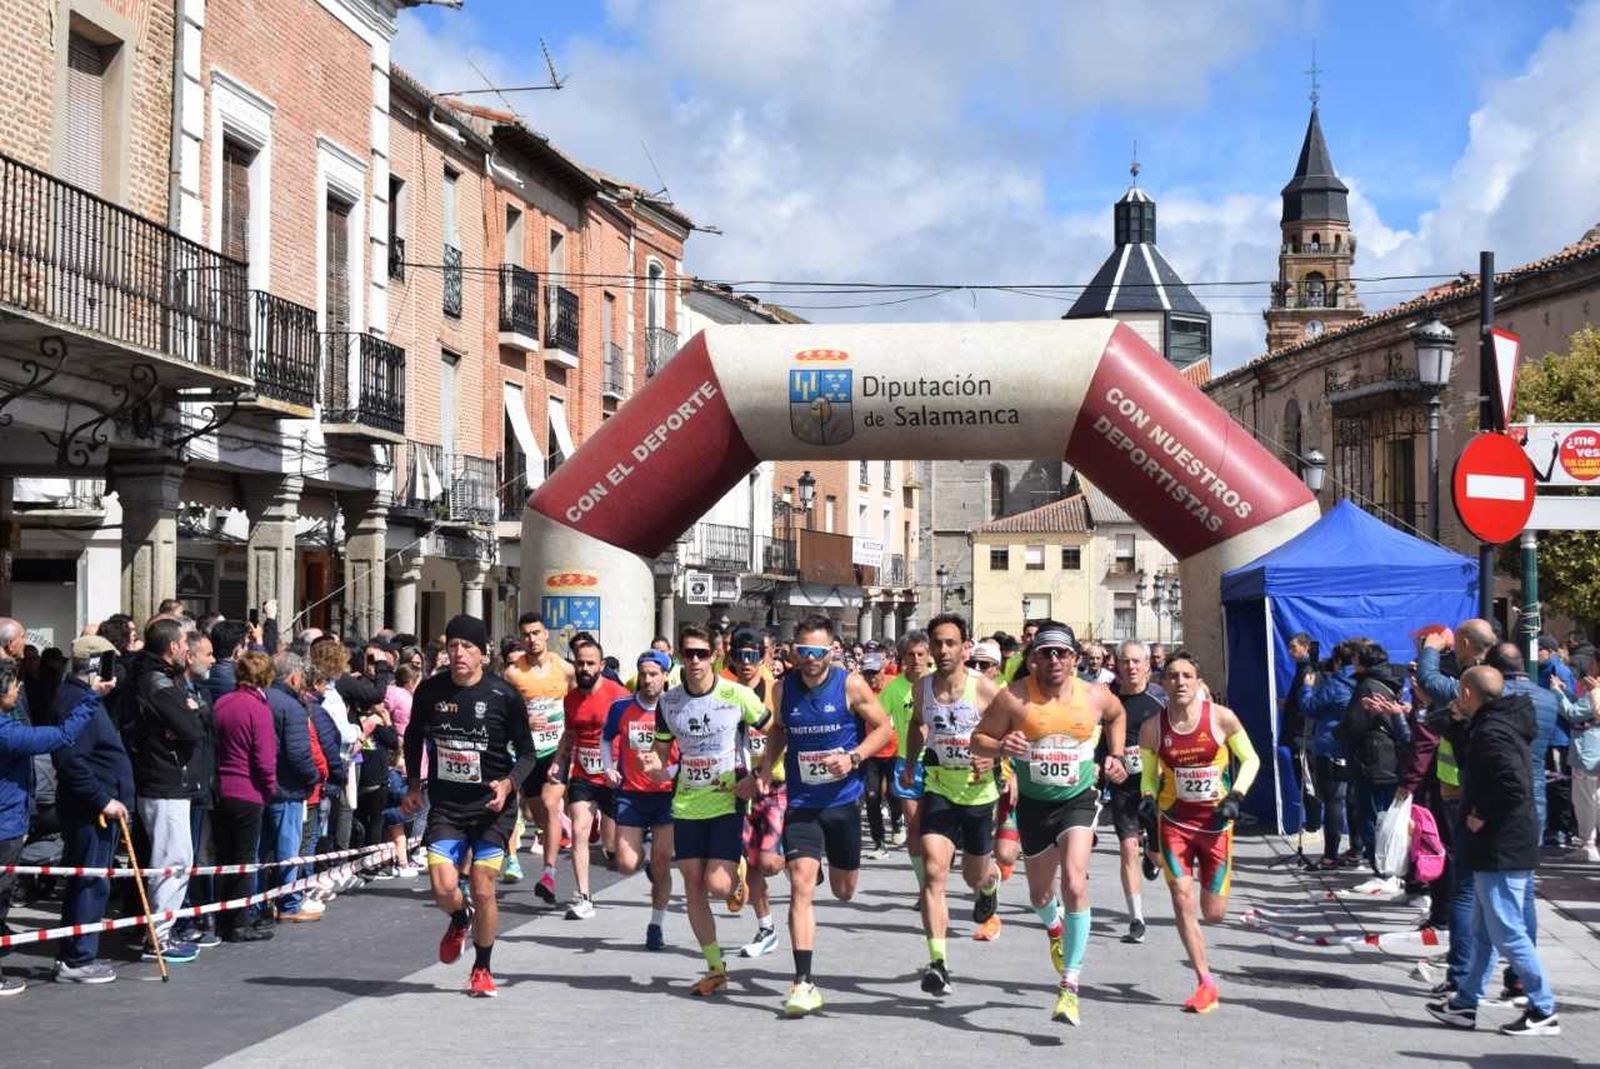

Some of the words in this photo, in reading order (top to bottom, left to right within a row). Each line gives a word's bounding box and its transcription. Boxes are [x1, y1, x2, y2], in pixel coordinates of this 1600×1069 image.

[862, 373, 991, 402] Diputación
[864, 411, 885, 427] de
[894, 405, 1019, 427] Salamanca
[1566, 436, 1597, 450] ¿me
[565, 481, 609, 523] CON
[606, 462, 635, 486] EL
[631, 380, 718, 463] DEPORTE
[1105, 388, 1150, 428] CON
[1148, 425, 1252, 518] NUESTROS
[1093, 415, 1222, 532] DEPORTISTAS
[539, 731, 559, 743] 355
[445, 761, 471, 775] 333
[687, 768, 712, 781] 325
[1040, 762, 1070, 777] 305
[1185, 779, 1212, 793] 222
